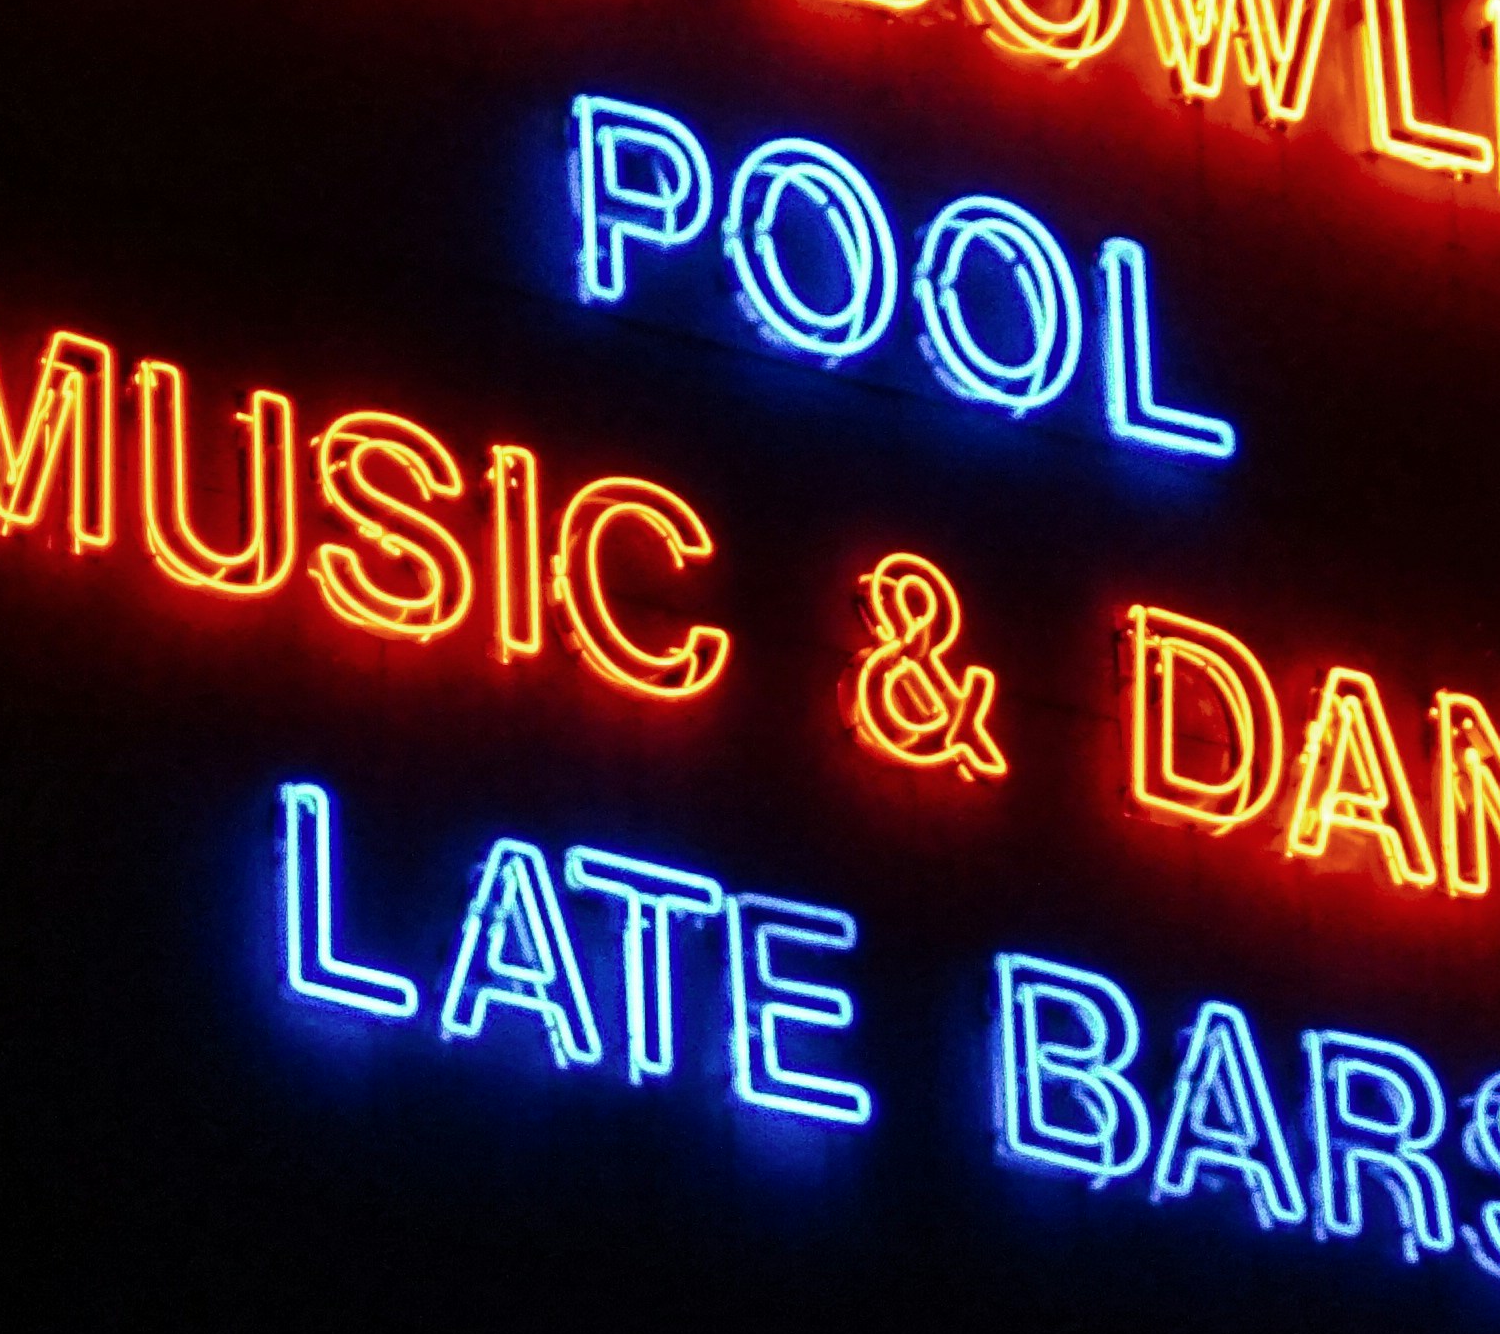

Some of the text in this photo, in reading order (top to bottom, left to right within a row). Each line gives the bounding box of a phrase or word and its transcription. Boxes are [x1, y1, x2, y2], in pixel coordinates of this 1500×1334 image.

[571, 95, 1235, 458] POOL
[852, 552, 1007, 775] &
[280, 783, 872, 1123] LATE
